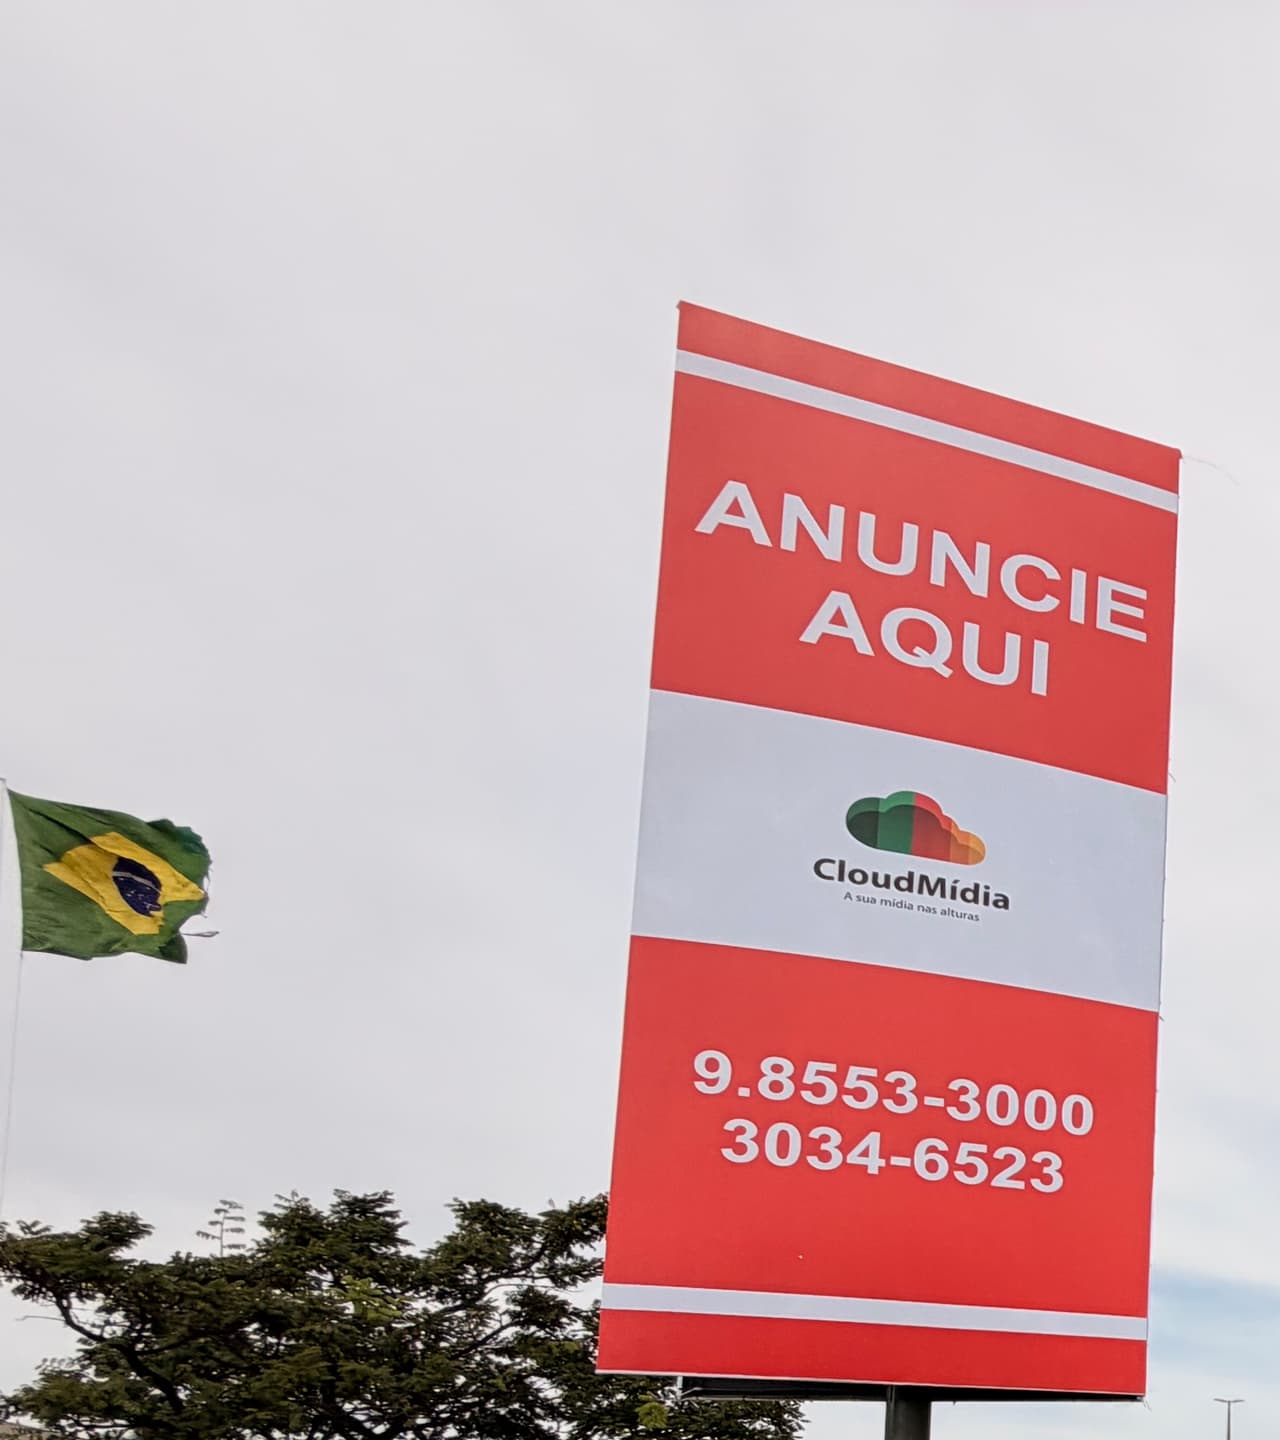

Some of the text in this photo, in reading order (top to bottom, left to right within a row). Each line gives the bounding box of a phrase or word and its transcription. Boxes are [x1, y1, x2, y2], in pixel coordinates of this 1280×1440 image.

[695, 480, 1148, 642] ANUNCIE
[799, 590, 1050, 697] AQUI
[813, 857, 1010, 910] CloudMídia
[844, 891, 980, 922] A sua mídia nas alturas
[693, 1049, 1094, 1136] 9.8553-3000
[720, 1118, 1064, 1194] 3034-6523
